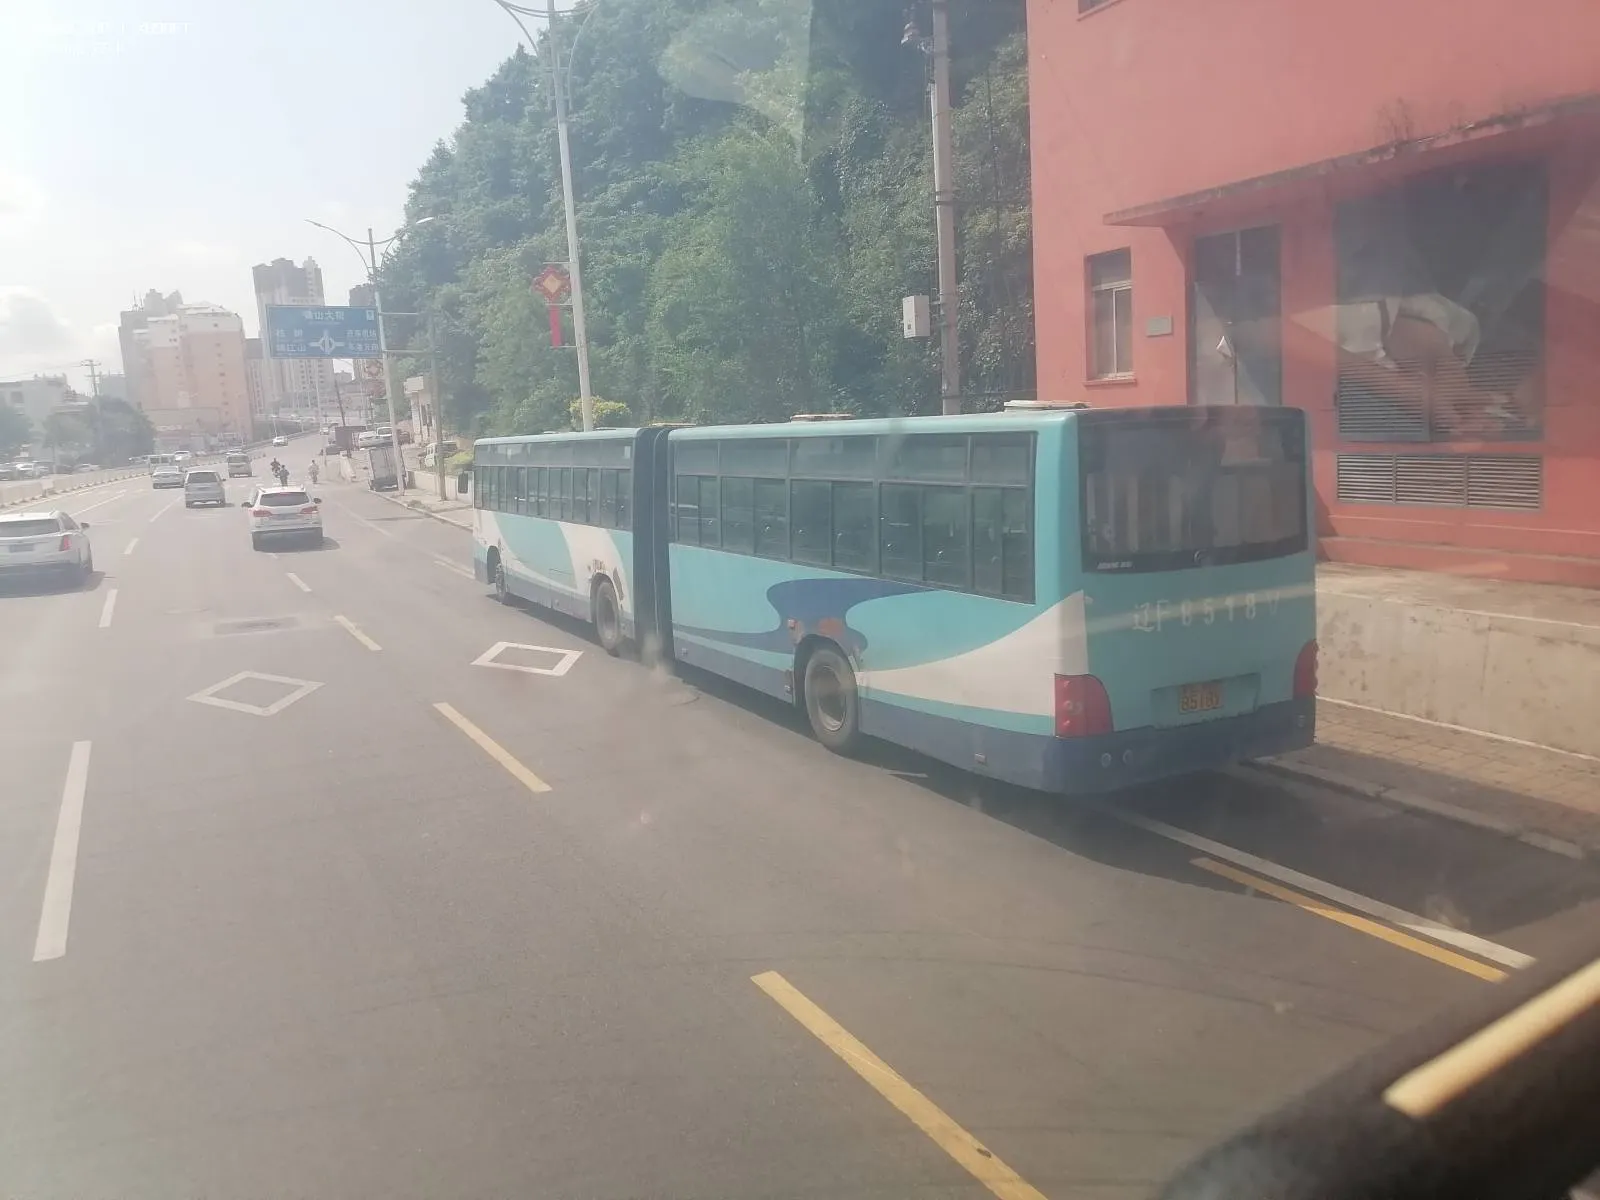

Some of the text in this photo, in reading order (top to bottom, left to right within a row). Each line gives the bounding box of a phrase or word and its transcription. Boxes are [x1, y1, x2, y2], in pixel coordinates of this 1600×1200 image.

[303, 310, 344, 321] 山大街
[277, 343, 307, 352] 江山
